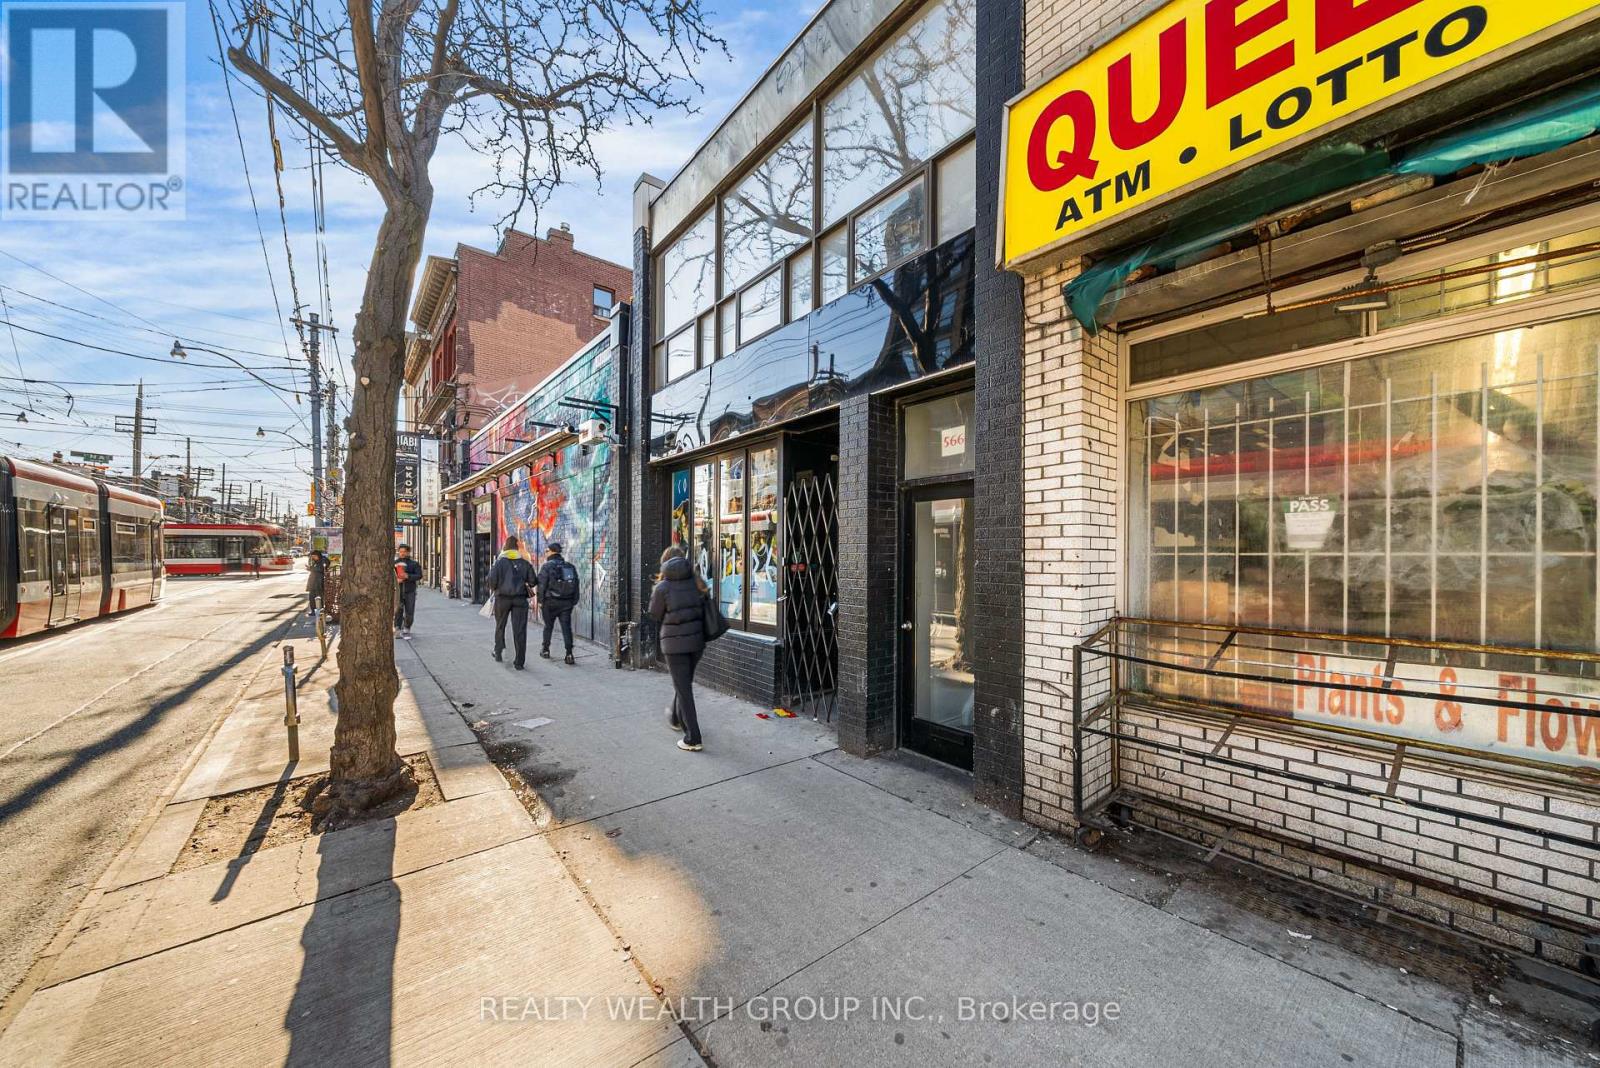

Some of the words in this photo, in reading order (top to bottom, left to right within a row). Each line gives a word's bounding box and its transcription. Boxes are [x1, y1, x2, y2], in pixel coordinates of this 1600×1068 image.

[1055, 159, 1152, 231] ATM
[1229, 4, 1488, 151] LOTTO
[943, 433, 966, 448] 566
[1289, 499, 1330, 513] PASS
[1295, 652, 1405, 726] Plants
[1434, 667, 1463, 732] &
